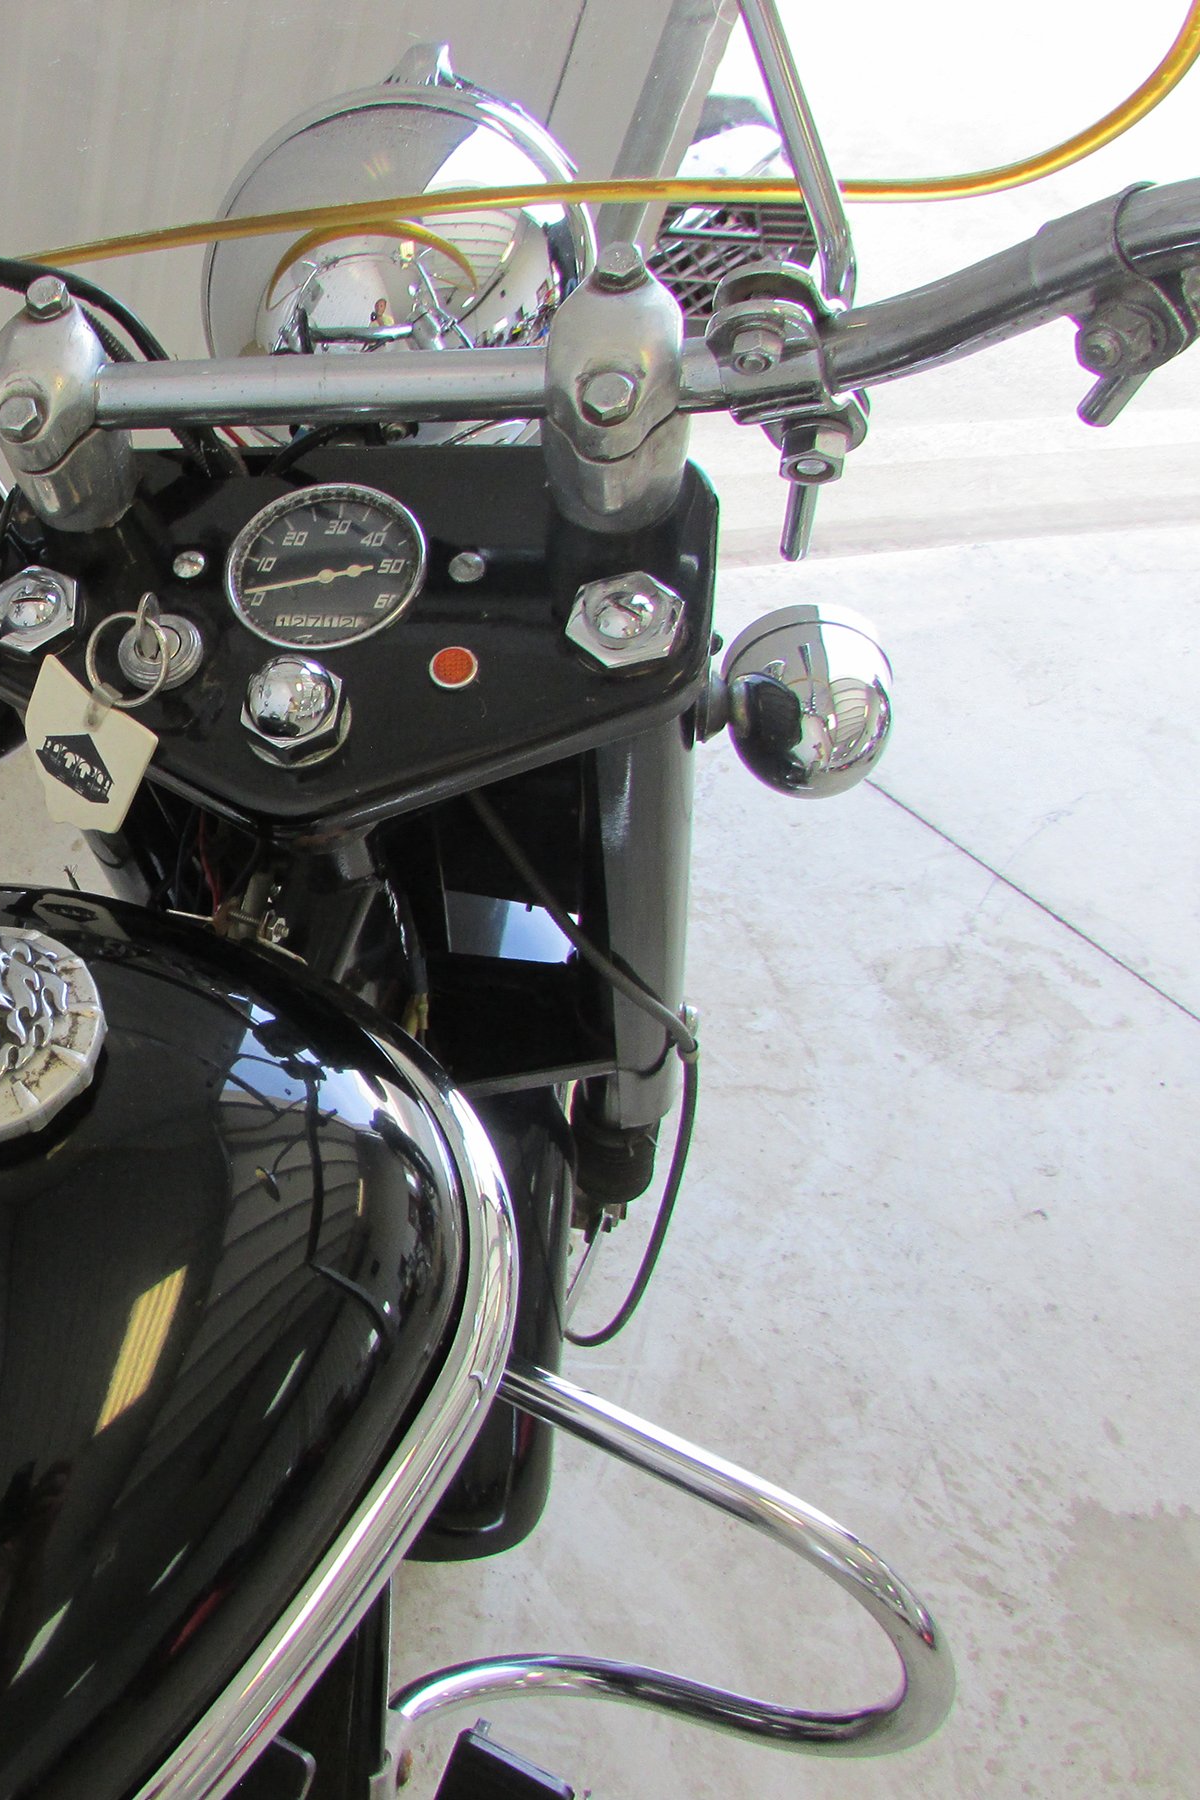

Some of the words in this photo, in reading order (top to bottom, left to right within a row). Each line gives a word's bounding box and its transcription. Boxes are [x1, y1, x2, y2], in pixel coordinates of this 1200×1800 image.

[324, 520, 351, 535] 30
[282, 531, 308, 546] 20
[360, 532, 386, 547] 40
[257, 557, 277, 572] 10
[377, 559, 405, 573] 50
[251, 592, 265, 606] 0
